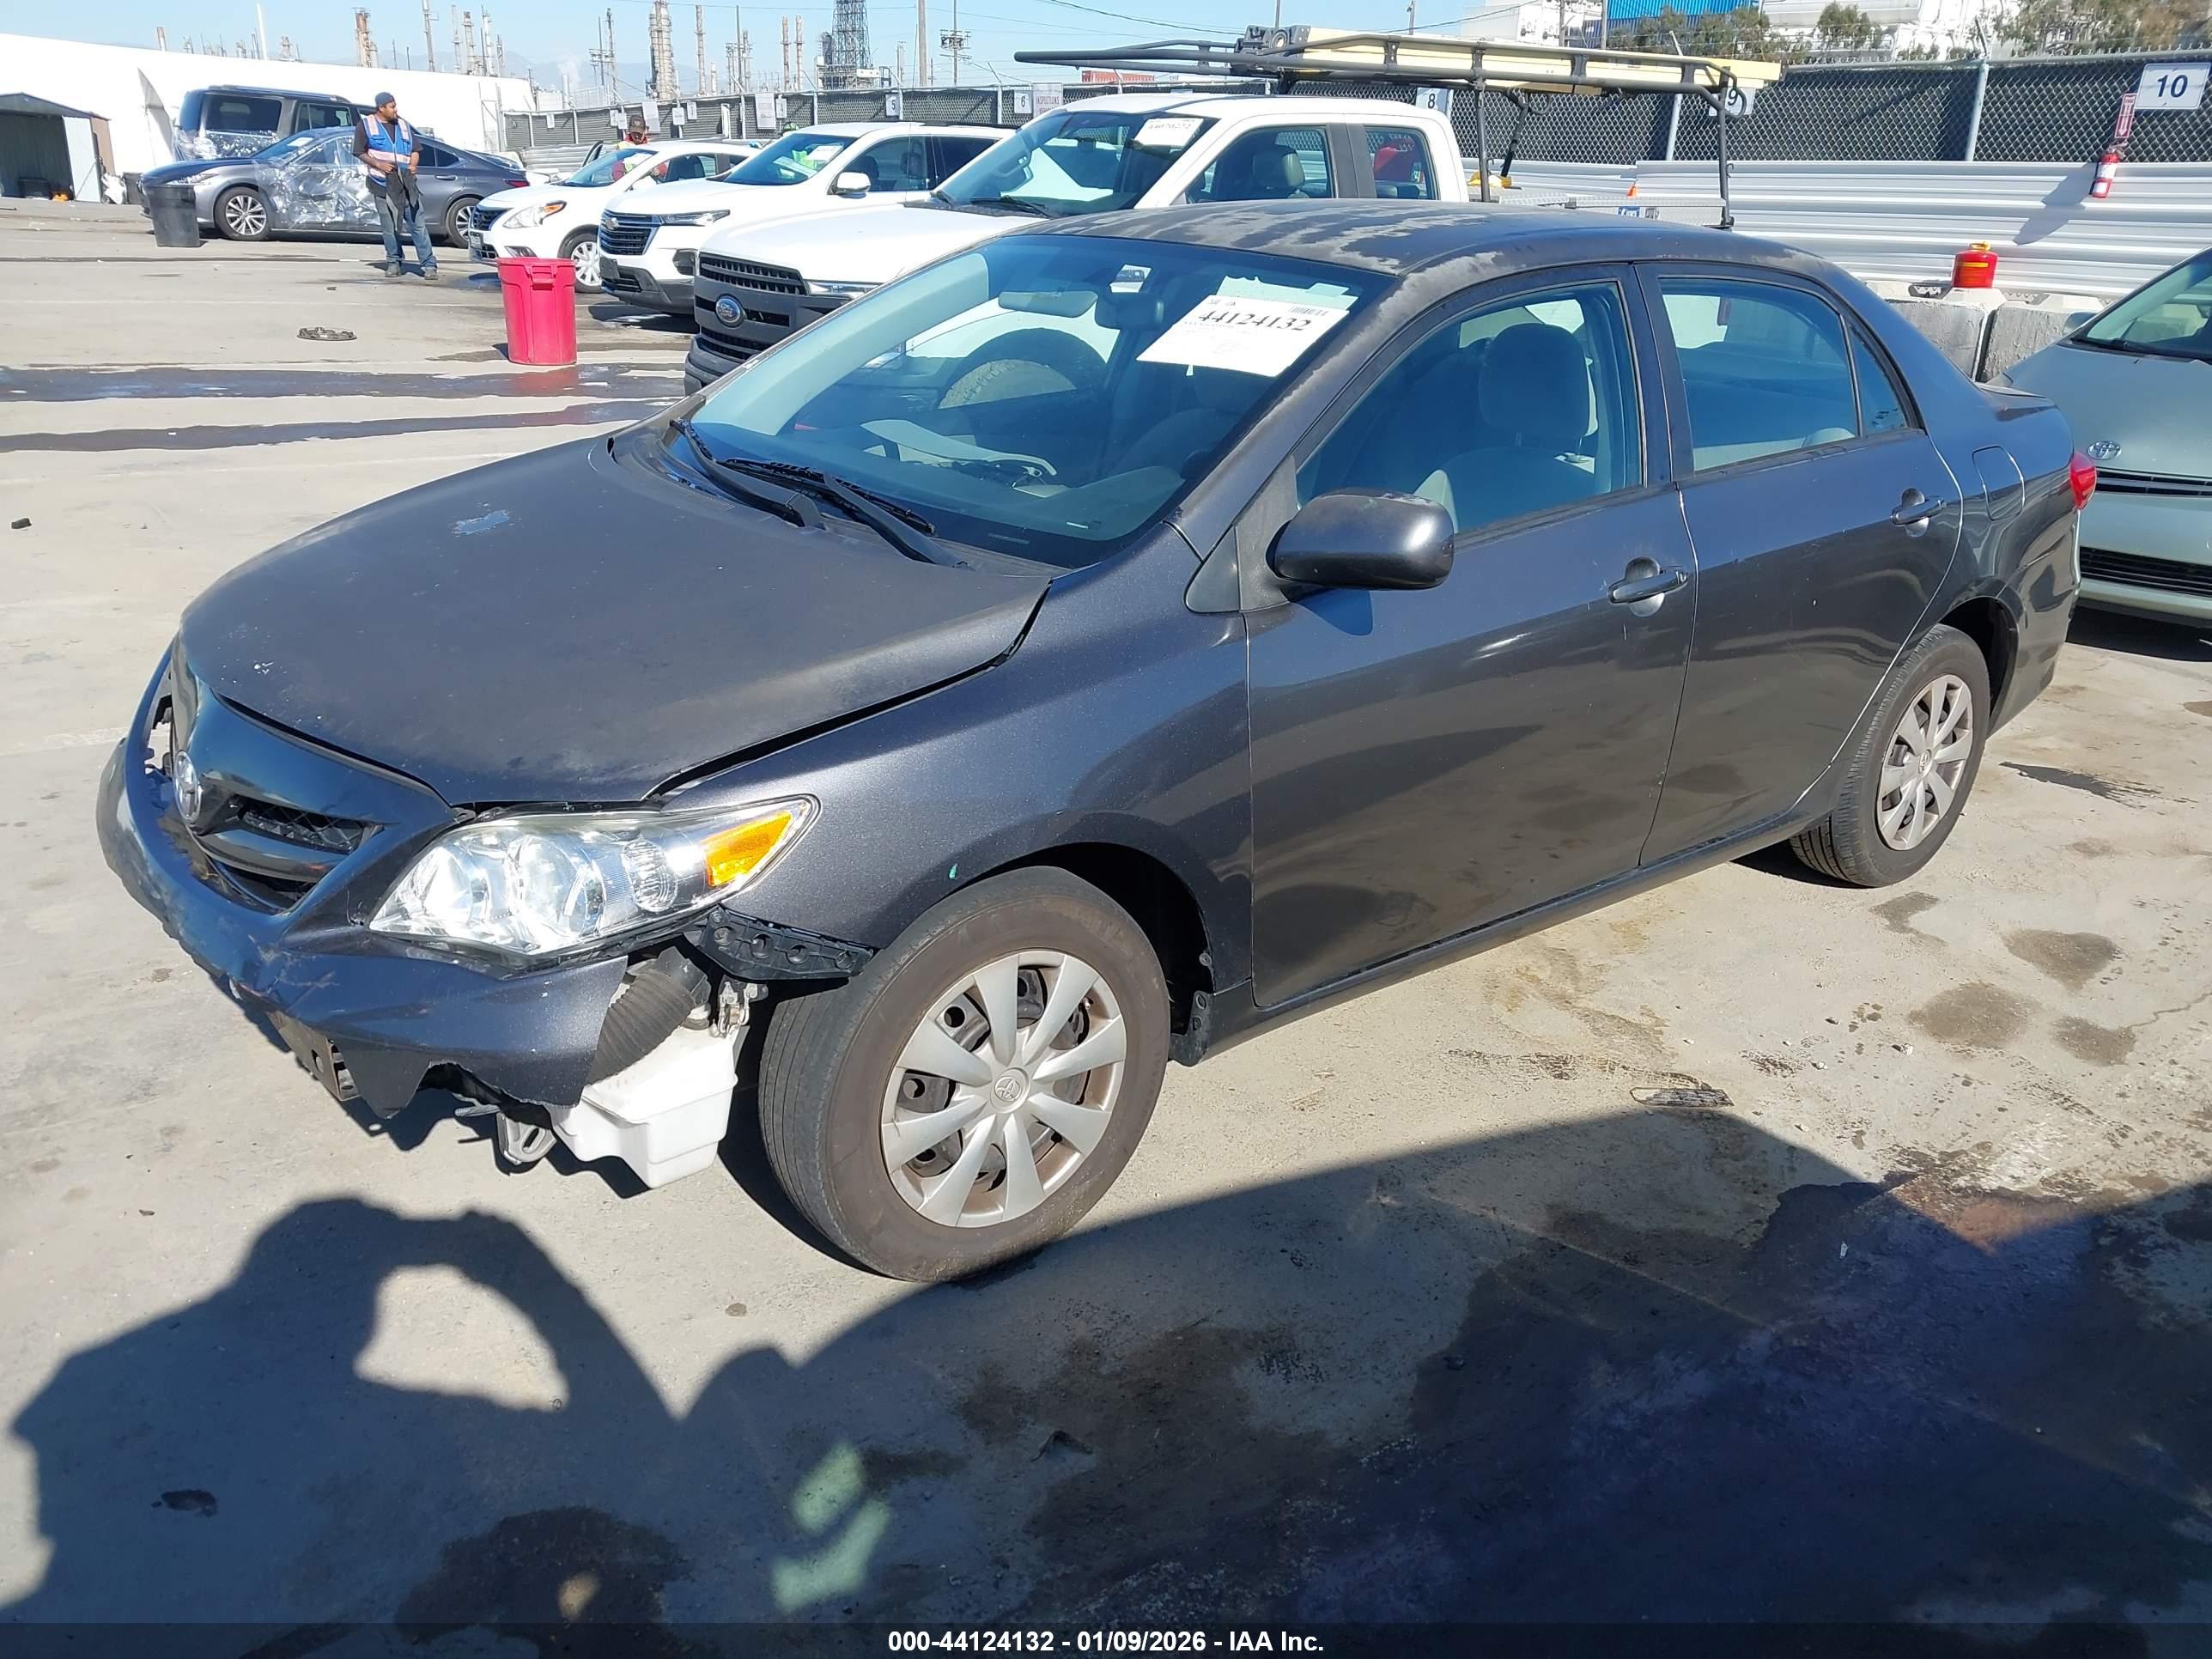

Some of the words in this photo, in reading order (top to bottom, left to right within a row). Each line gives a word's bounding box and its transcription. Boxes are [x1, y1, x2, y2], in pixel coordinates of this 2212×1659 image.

[2157, 74, 2189, 98] 10
[890, 99, 896, 110] 5
[1020, 95, 1026, 108] 6
[1427, 93, 1436, 109] 8
[1727, 88, 1738, 106] 9
[1199, 310, 1312, 331] 44124132
